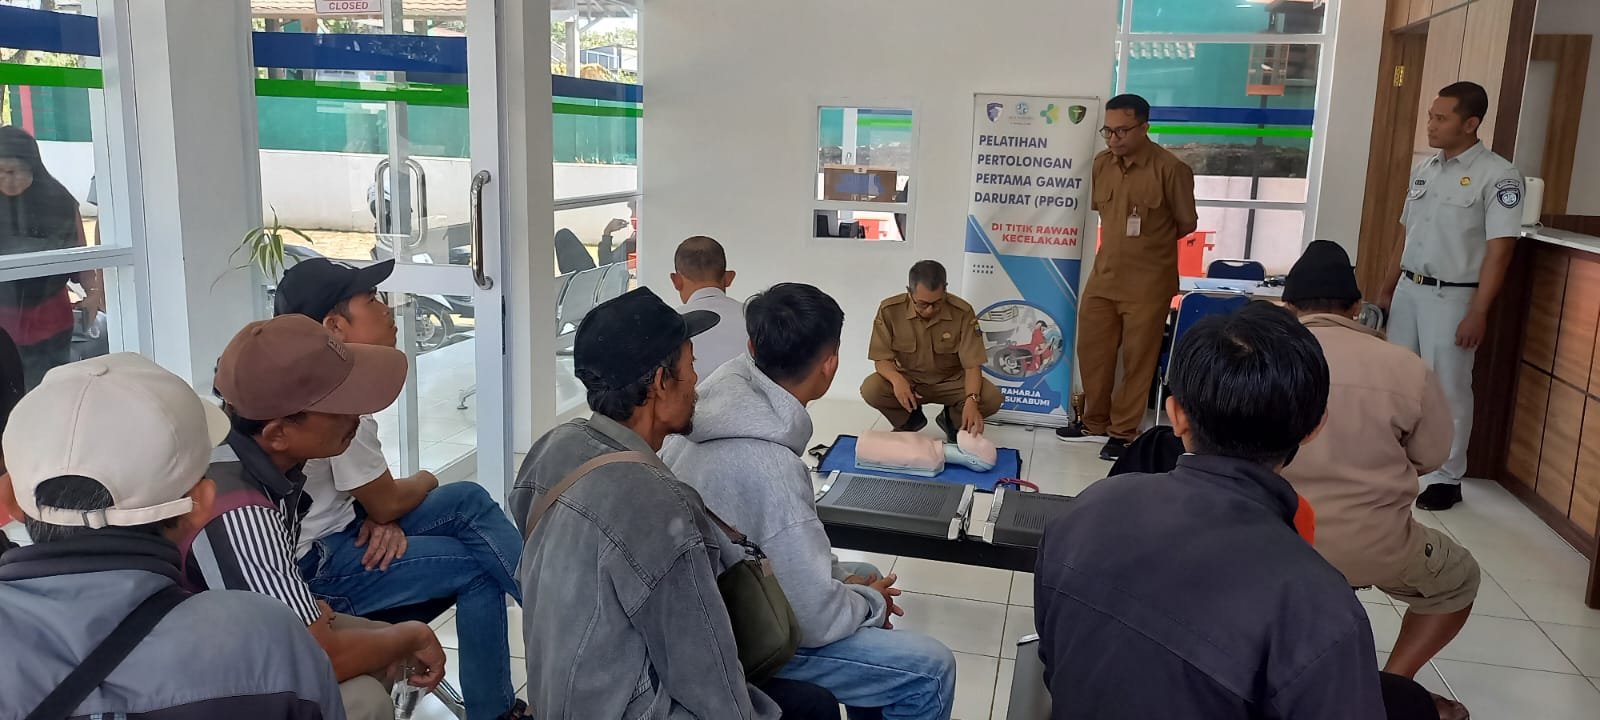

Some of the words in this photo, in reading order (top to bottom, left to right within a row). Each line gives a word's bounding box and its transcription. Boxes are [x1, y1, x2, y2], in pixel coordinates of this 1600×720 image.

[329, 2, 368, 10] CLOSED
[979, 135, 1047, 148] PELATIHAN
[978, 154, 1072, 169] PERTOLONGAN
[976, 173, 1032, 186] PERTAMA
[1036, 177, 1082, 189] GAWAT
[974, 192, 1031, 205] DARURAT
[1034, 195, 1078, 210] (PPGD)
[991, 223, 1003, 231] DI
[1006, 224, 1033, 233] TITIK
[1036, 225, 1078, 236] RAWAN
[1001, 234, 1077, 246] KECELAKAAN
[1001, 387, 1041, 397] RAHARJA
[1004, 395, 1050, 406] SUKABUMI
